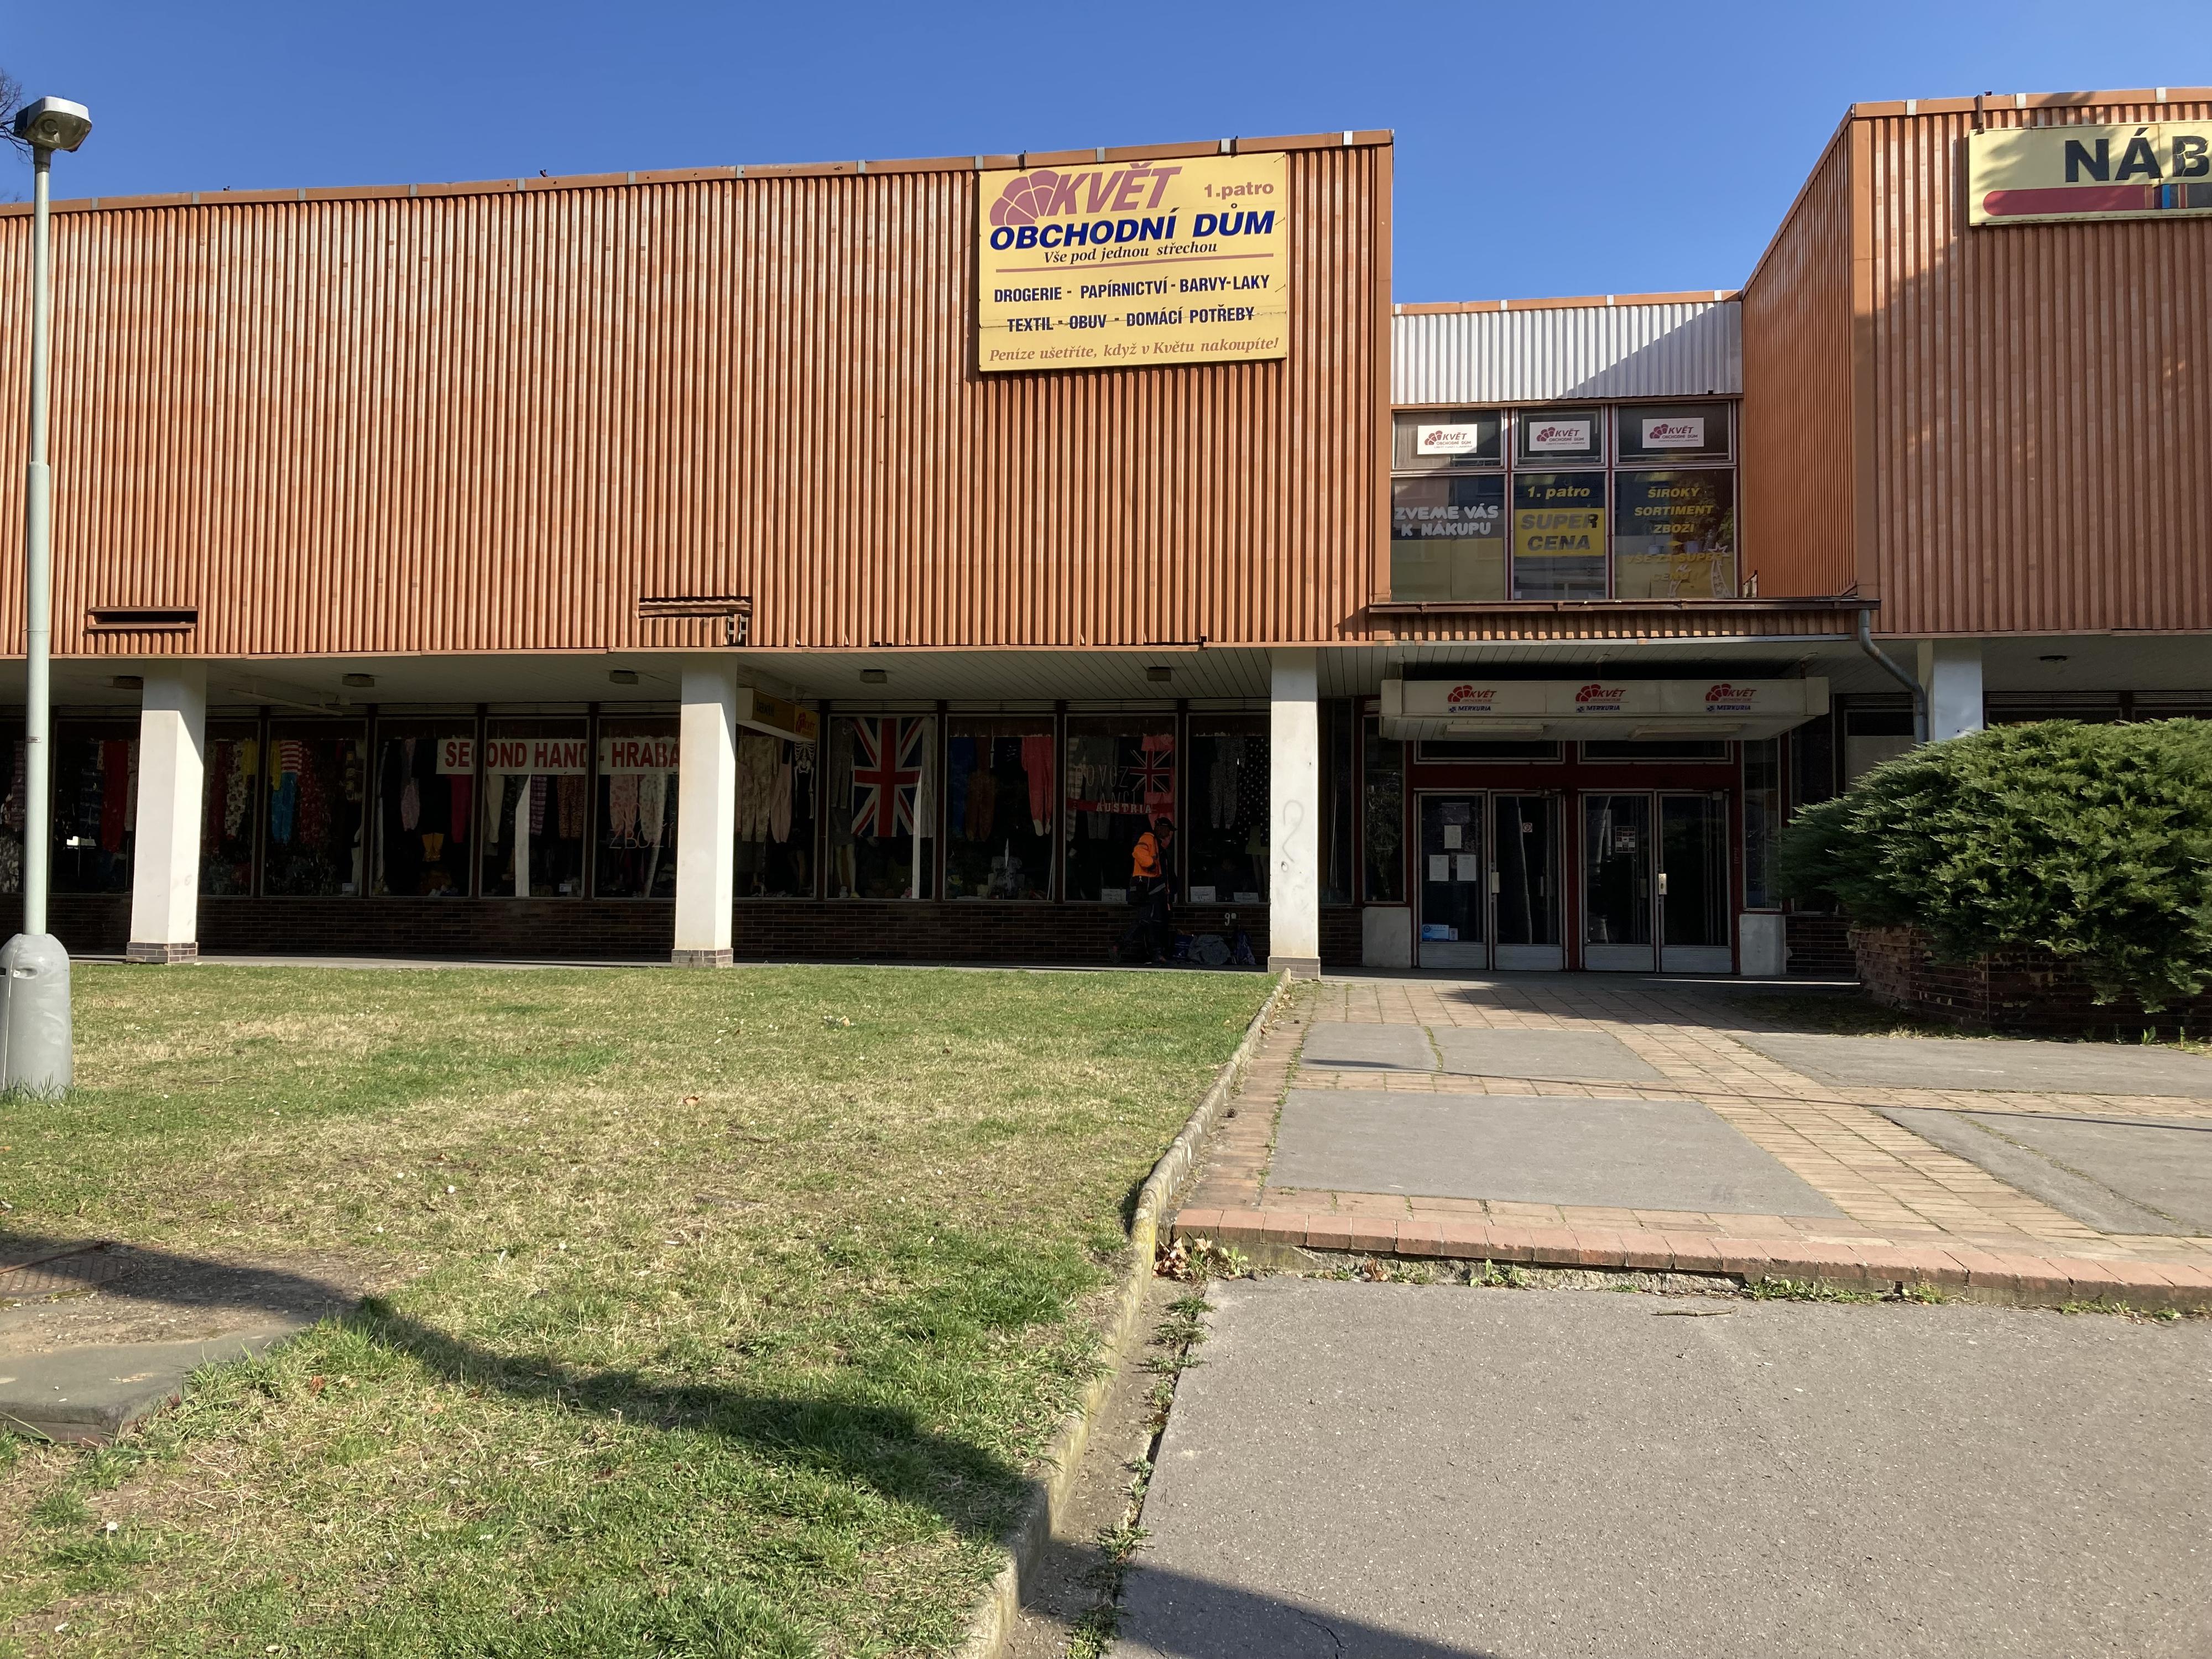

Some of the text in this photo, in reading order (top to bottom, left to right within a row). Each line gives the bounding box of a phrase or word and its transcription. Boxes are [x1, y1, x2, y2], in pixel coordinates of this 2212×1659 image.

[2065, 127, 2210, 182] NÁB
[1045, 162, 1182, 217] KVĚT
[990, 203, 1275, 251] OBCHODNÍ DŮM
[1044, 241, 1218, 265] Vše pod jednou střechou
[994, 286, 1062, 302] DROGERIE
[1081, 276, 1168, 299] PAPÍRNICTVÍ
[1007, 317, 1053, 332] TEXTIL
[1069, 314, 1107, 330] OBUV
[1126, 306, 1183, 327] DOMÁCÍ
[1189, 304, 1255, 324] POTŘEBY
[989, 337, 1279, 361] Peníze ušetříte, když v Květu nakoupíte!
[1442, 432, 1467, 440] KVĚT
[1555, 428, 1580, 437] KVĚT
[1668, 425, 1694, 434] KVĚT
[1545, 486, 1590, 499] patro
[1395, 503, 1499, 520] ZVEME VÁS
[1634, 504, 1714, 516] SORTIMENT
[1401, 520, 1491, 536] K NÁKUPU
[1521, 513, 1599, 530] SUPER
[1527, 535, 1590, 551] CENA
[1469, 689, 1497, 697] KVĚT
[1597, 688, 1626, 697] KVĚT
[1727, 688, 1757, 697] KVĚT
[445, 742, 527, 768] SEOND
[1096, 802, 1151, 813] AUSTRIA
